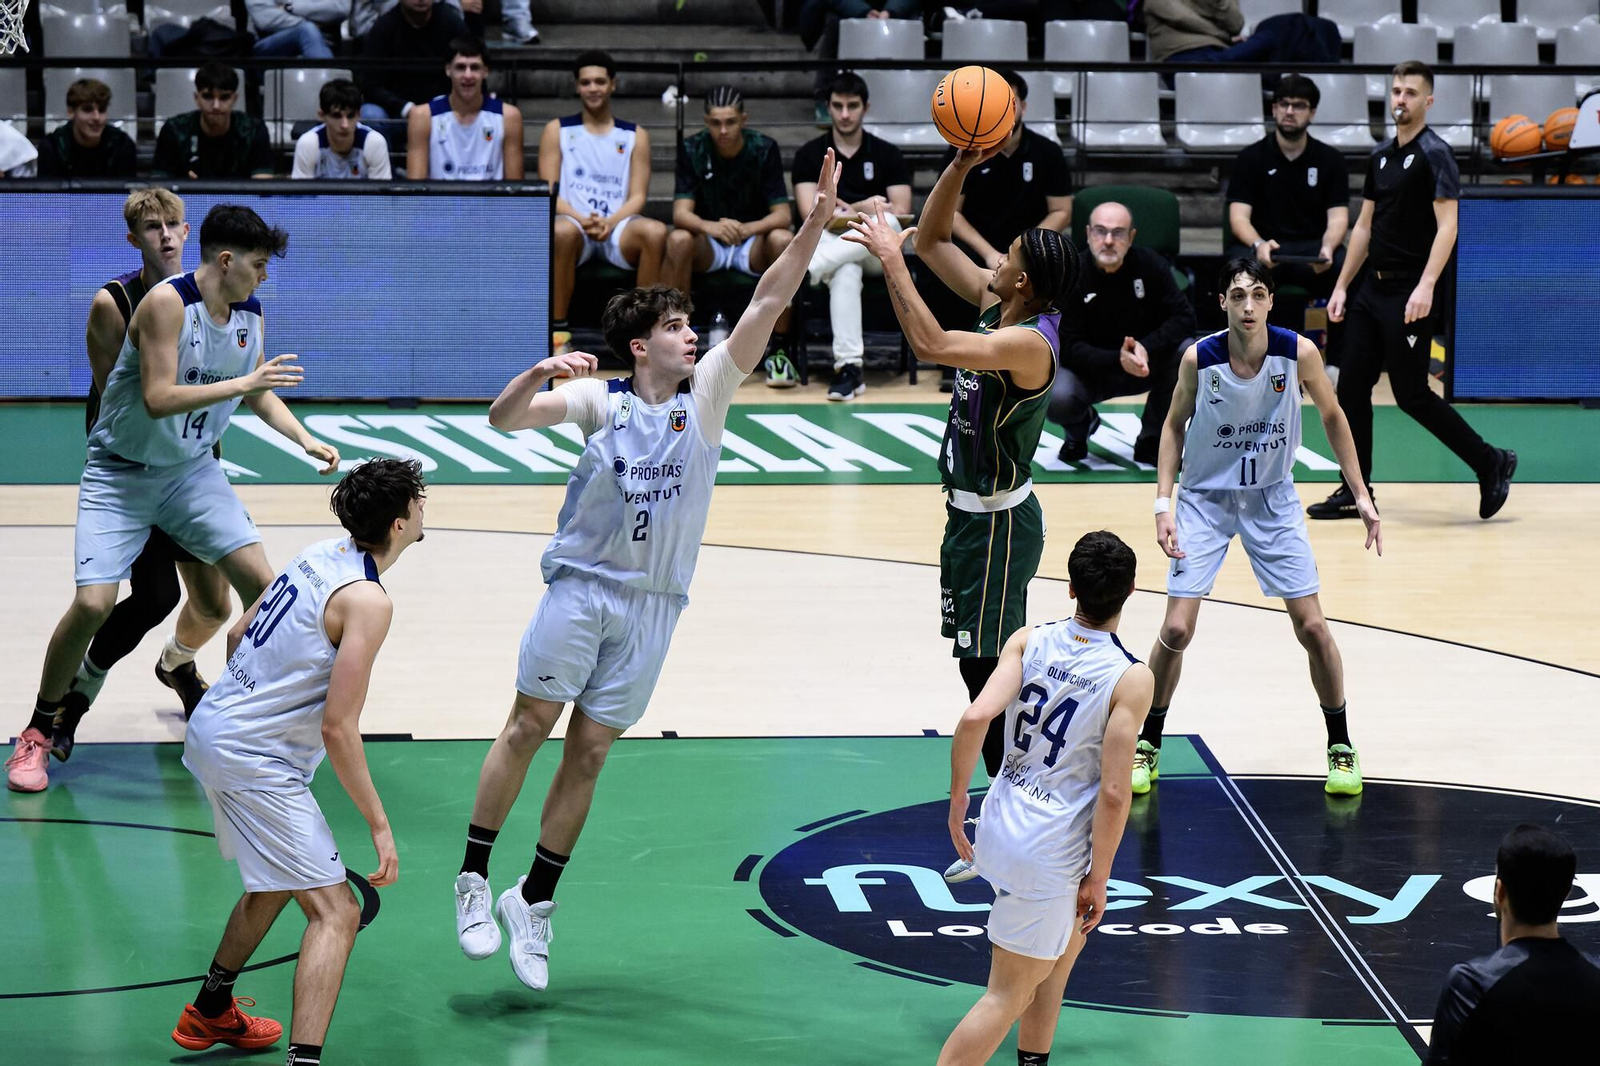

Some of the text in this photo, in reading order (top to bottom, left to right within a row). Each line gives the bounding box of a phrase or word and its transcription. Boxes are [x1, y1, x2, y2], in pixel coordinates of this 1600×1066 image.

[181, 410, 209, 440] 14
[1238, 421, 1286, 436] PROBITAS
[1213, 436, 1288, 454] JOVENTUT
[630, 464, 683, 481] PROBTAS
[1239, 456, 1258, 487] 11
[615, 484, 683, 505] VENTUT
[631, 509, 650, 542] 2
[244, 573, 298, 649] 20
[1013, 682, 1080, 770] 24
[886, 917, 1290, 938] Lo code
